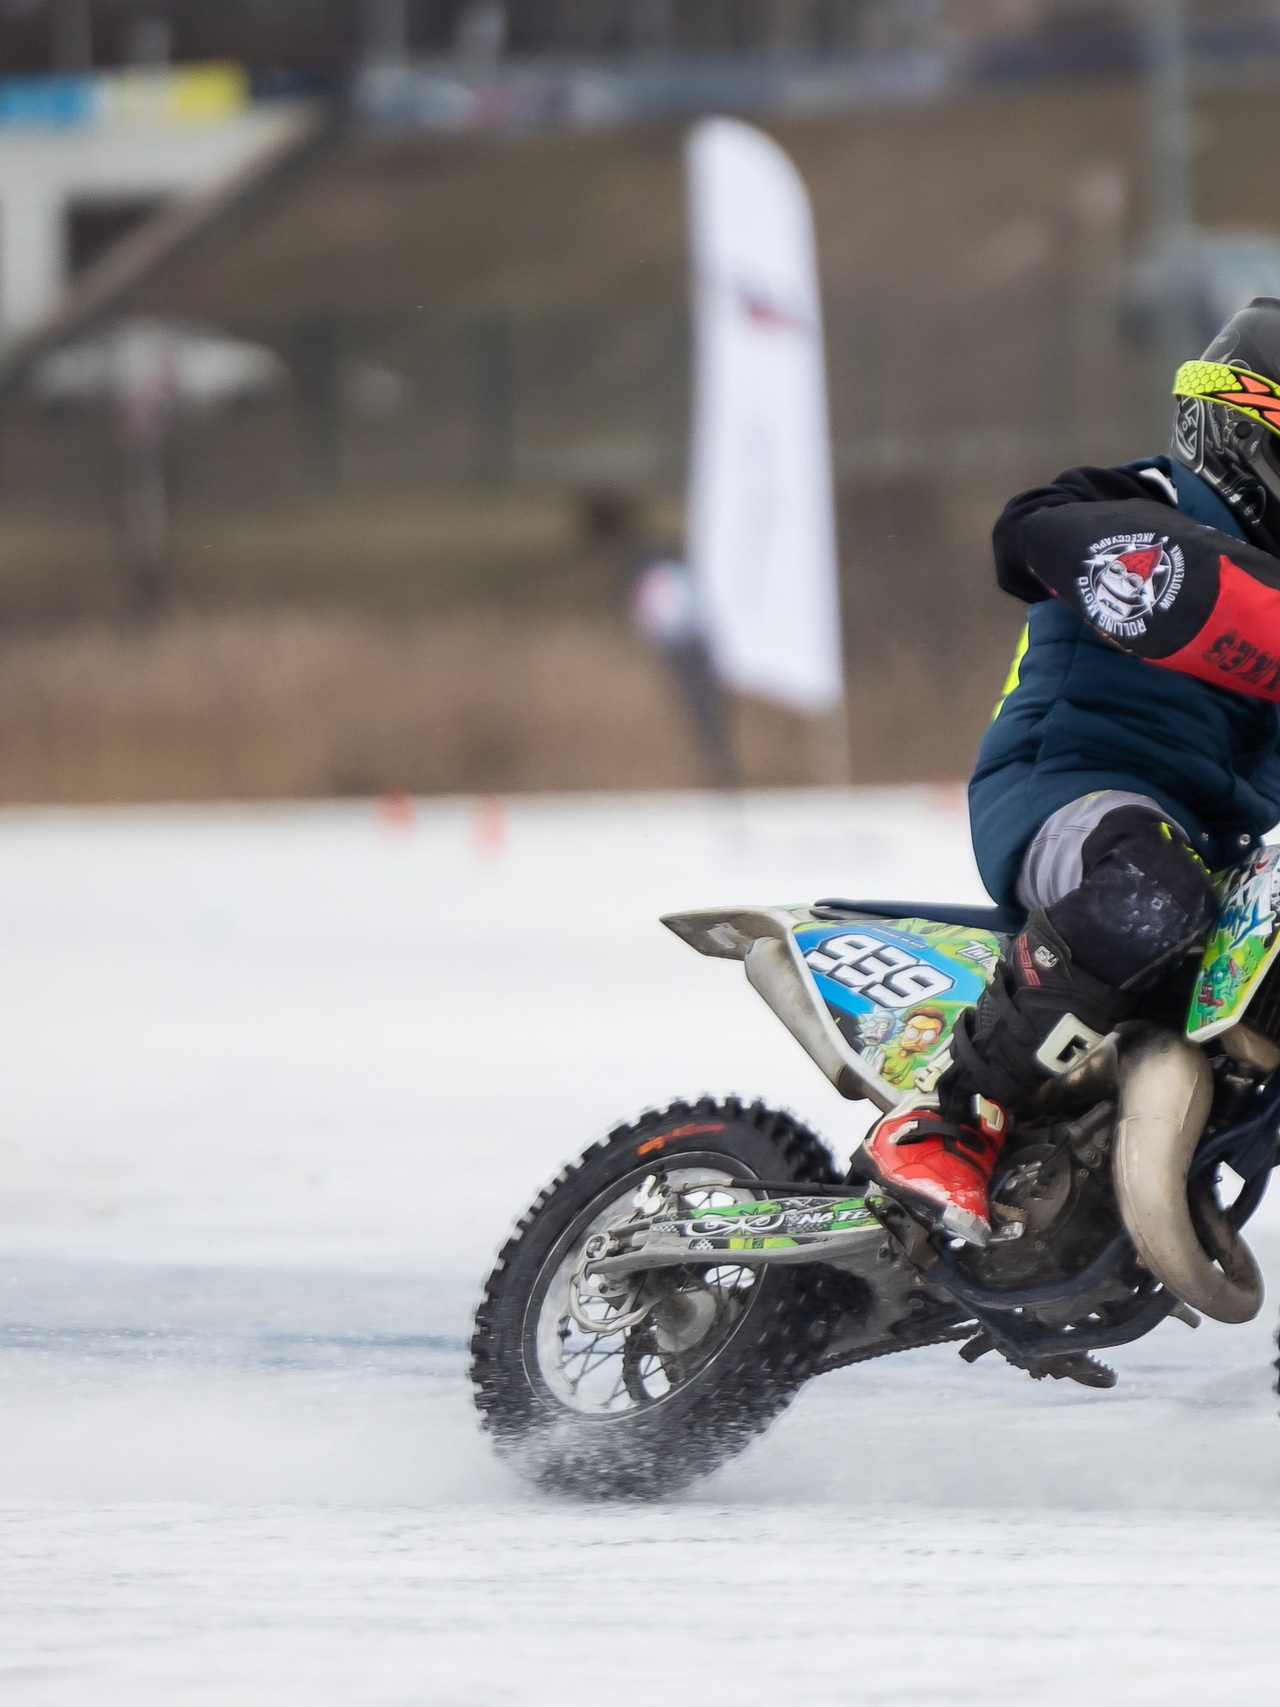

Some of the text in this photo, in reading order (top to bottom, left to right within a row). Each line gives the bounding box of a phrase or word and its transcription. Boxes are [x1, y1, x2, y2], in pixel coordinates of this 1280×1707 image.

[1089, 532, 1156, 553] АКСЕССУАРЫ
[1079, 576, 1100, 617] MOTO
[1160, 544, 1185, 609] МОТОТЕХНИКА
[1098, 615, 1147, 636] ROLLING
[803, 932, 957, 1009] 939
